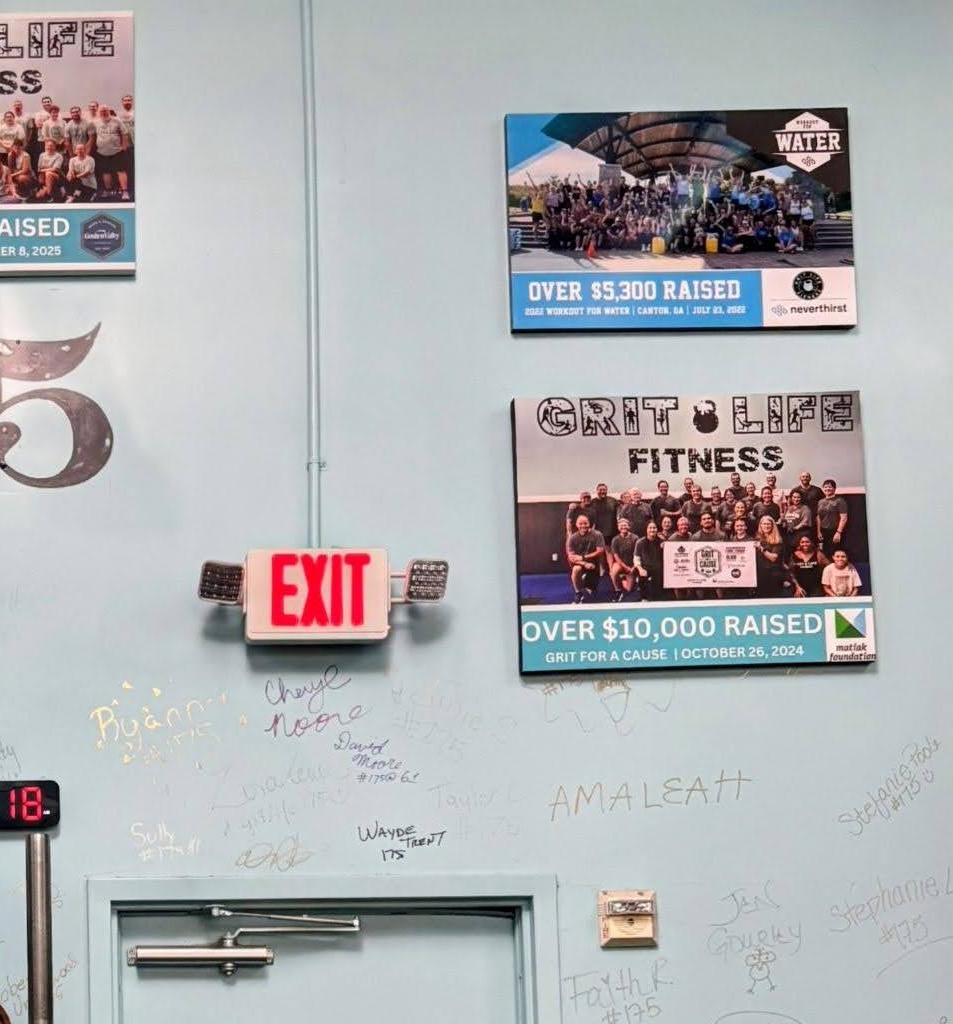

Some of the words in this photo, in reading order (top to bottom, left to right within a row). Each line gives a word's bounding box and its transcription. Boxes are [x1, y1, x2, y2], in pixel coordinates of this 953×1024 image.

[775, 132, 841, 151] WATER
[19, 246, 30, 258] 8,
[32, 245, 62, 256] 2025
[528, 281, 582, 302] OVER
[591, 280, 657, 302] $5,300
[662, 279, 741, 300] RAISED
[546, 307, 585, 316] WORKOUT
[586, 307, 602, 315] FOR
[604, 306, 630, 315] WATER
[692, 306, 710, 314] JULY
[790, 303, 847, 314] neverthirst
[537, 397, 679, 437] GRIT
[733, 394, 854, 434] LIFE
[628, 446, 784, 474] FITNESS
[271, 553, 371, 626] EXIT
[522, 620, 595, 643] OVER
[602, 617, 717, 643] $10,000
[725, 614, 823, 637] RAISED
[546, 652, 577, 664] GRIT
[580, 650, 604, 662] FOR
[606, 650, 620, 662] A
[622, 648, 668, 661] CAUSE
[681, 646, 745, 660] OCTOBER
[748, 646, 769, 660] 26,
[771, 645, 805, 658] 2024
[830, 652, 877, 662] foundation
[265, 665, 351, 712] Cheryl
[550, 769, 752, 822] AMALEAH
[358, 820, 417, 842] WAYDE
